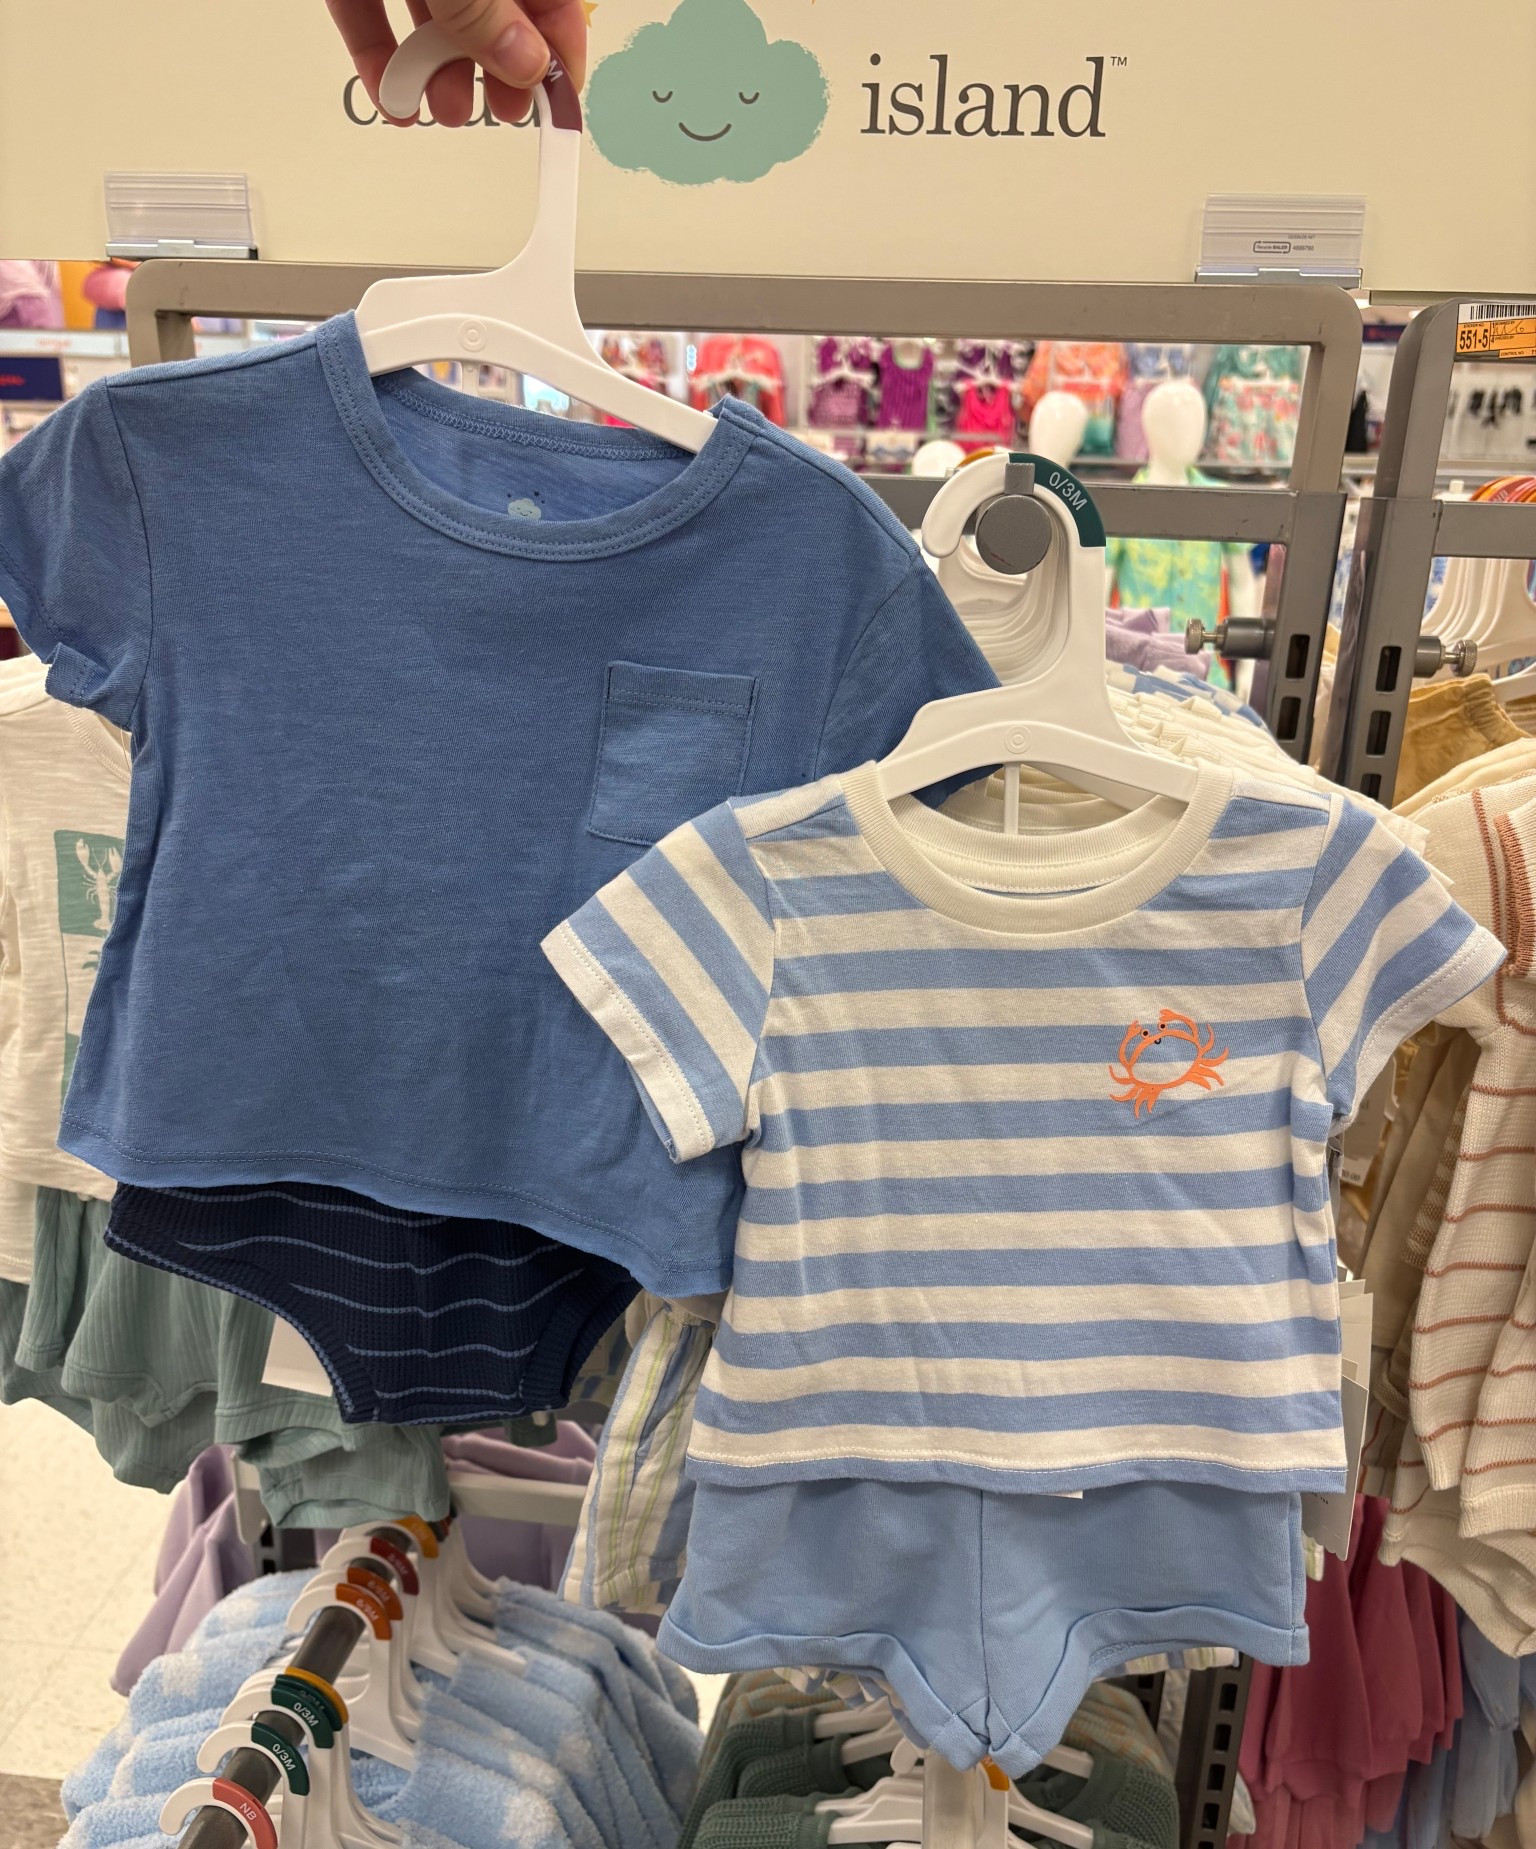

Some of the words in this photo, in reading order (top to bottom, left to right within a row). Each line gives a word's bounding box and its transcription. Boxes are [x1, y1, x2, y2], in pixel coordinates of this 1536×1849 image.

[860, 53, 1106, 138] island
[1459, 328, 1489, 350] 551-5
[1048, 471, 1088, 511] 0/3M
[293, 1702, 320, 1728] 0/3M
[272, 1743, 297, 1772] 0/3M
[239, 1802, 257, 1822] NB
